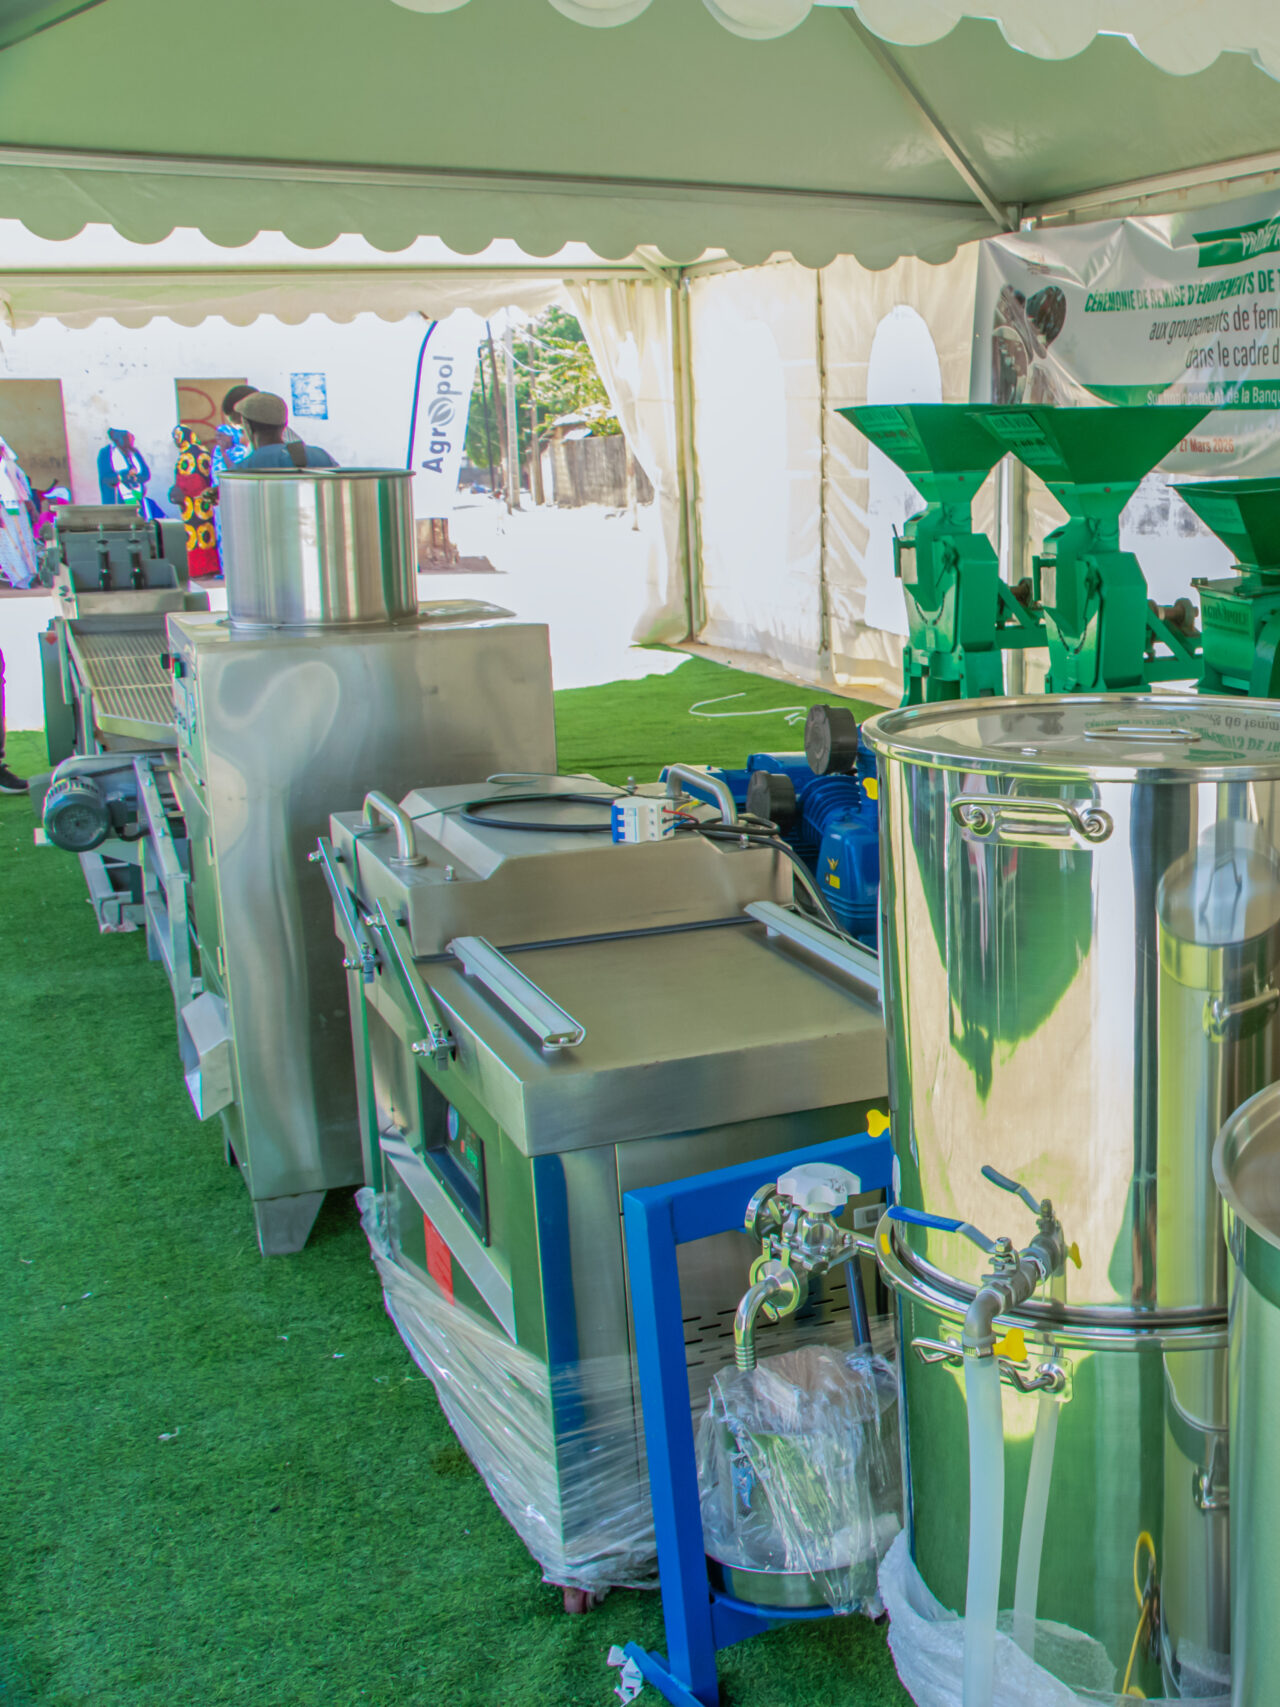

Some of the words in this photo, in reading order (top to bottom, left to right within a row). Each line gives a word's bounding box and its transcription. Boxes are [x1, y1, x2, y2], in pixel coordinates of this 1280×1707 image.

[1136, 289, 1149, 310] DE
[1151, 284, 1185, 309] REMISE
[1257, 269, 1275, 293] DE
[1149, 320, 1170, 341] aux
[1167, 309, 1230, 345] groupements
[1232, 303, 1250, 333] de
[1185, 343, 1215, 369] dans
[1217, 340, 1230, 368] le
[1232, 338, 1269, 367] cadre
[1226, 387, 1240, 404] de
[1241, 387, 1250, 403] la
[1190, 438, 1211, 453] Mars
